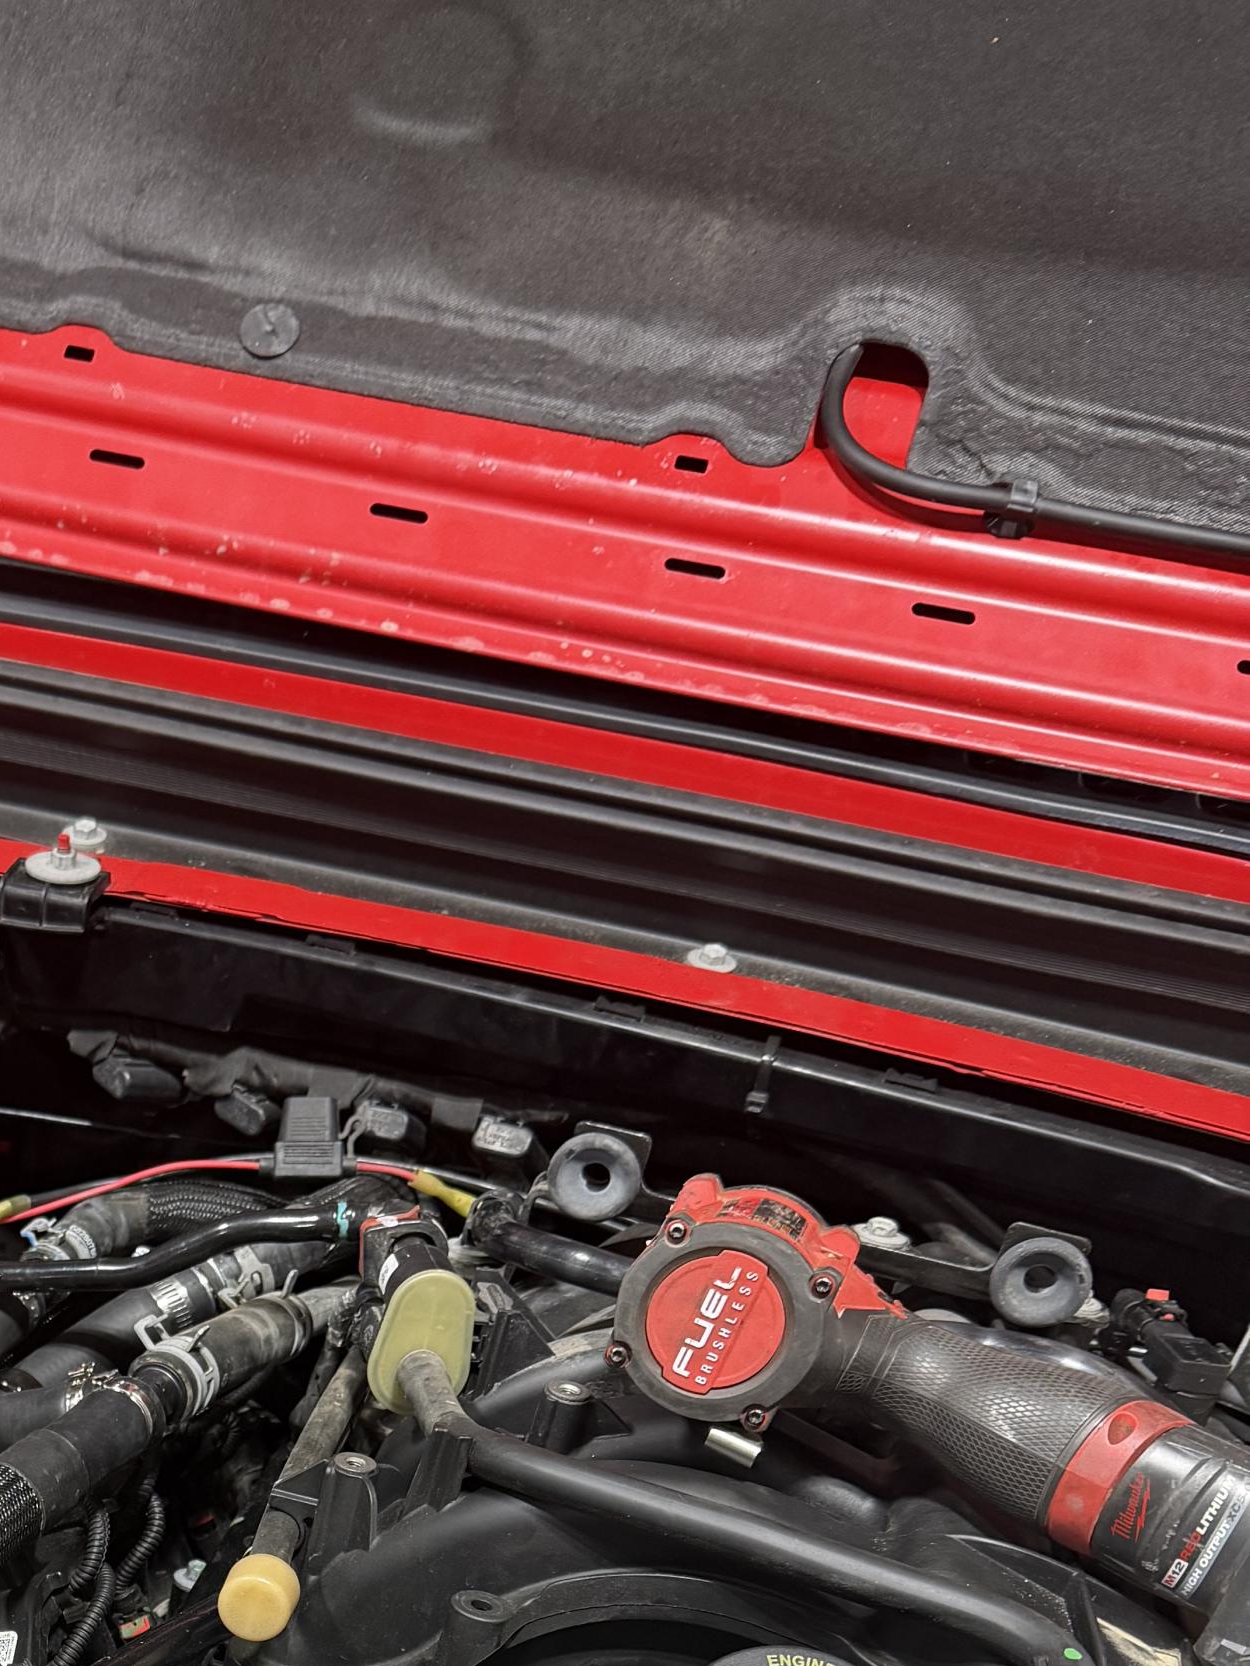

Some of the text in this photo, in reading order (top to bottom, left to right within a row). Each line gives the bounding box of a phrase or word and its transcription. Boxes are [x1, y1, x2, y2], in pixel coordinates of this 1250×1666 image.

[671, 1265, 741, 1377] FUEL
[694, 1269, 759, 1385] BRUSHLESS
[1162, 1559, 1188, 1588] M12
[1181, 1570, 1202, 1597] HIGH
[1200, 1523, 1232, 1567] OUTPUT
